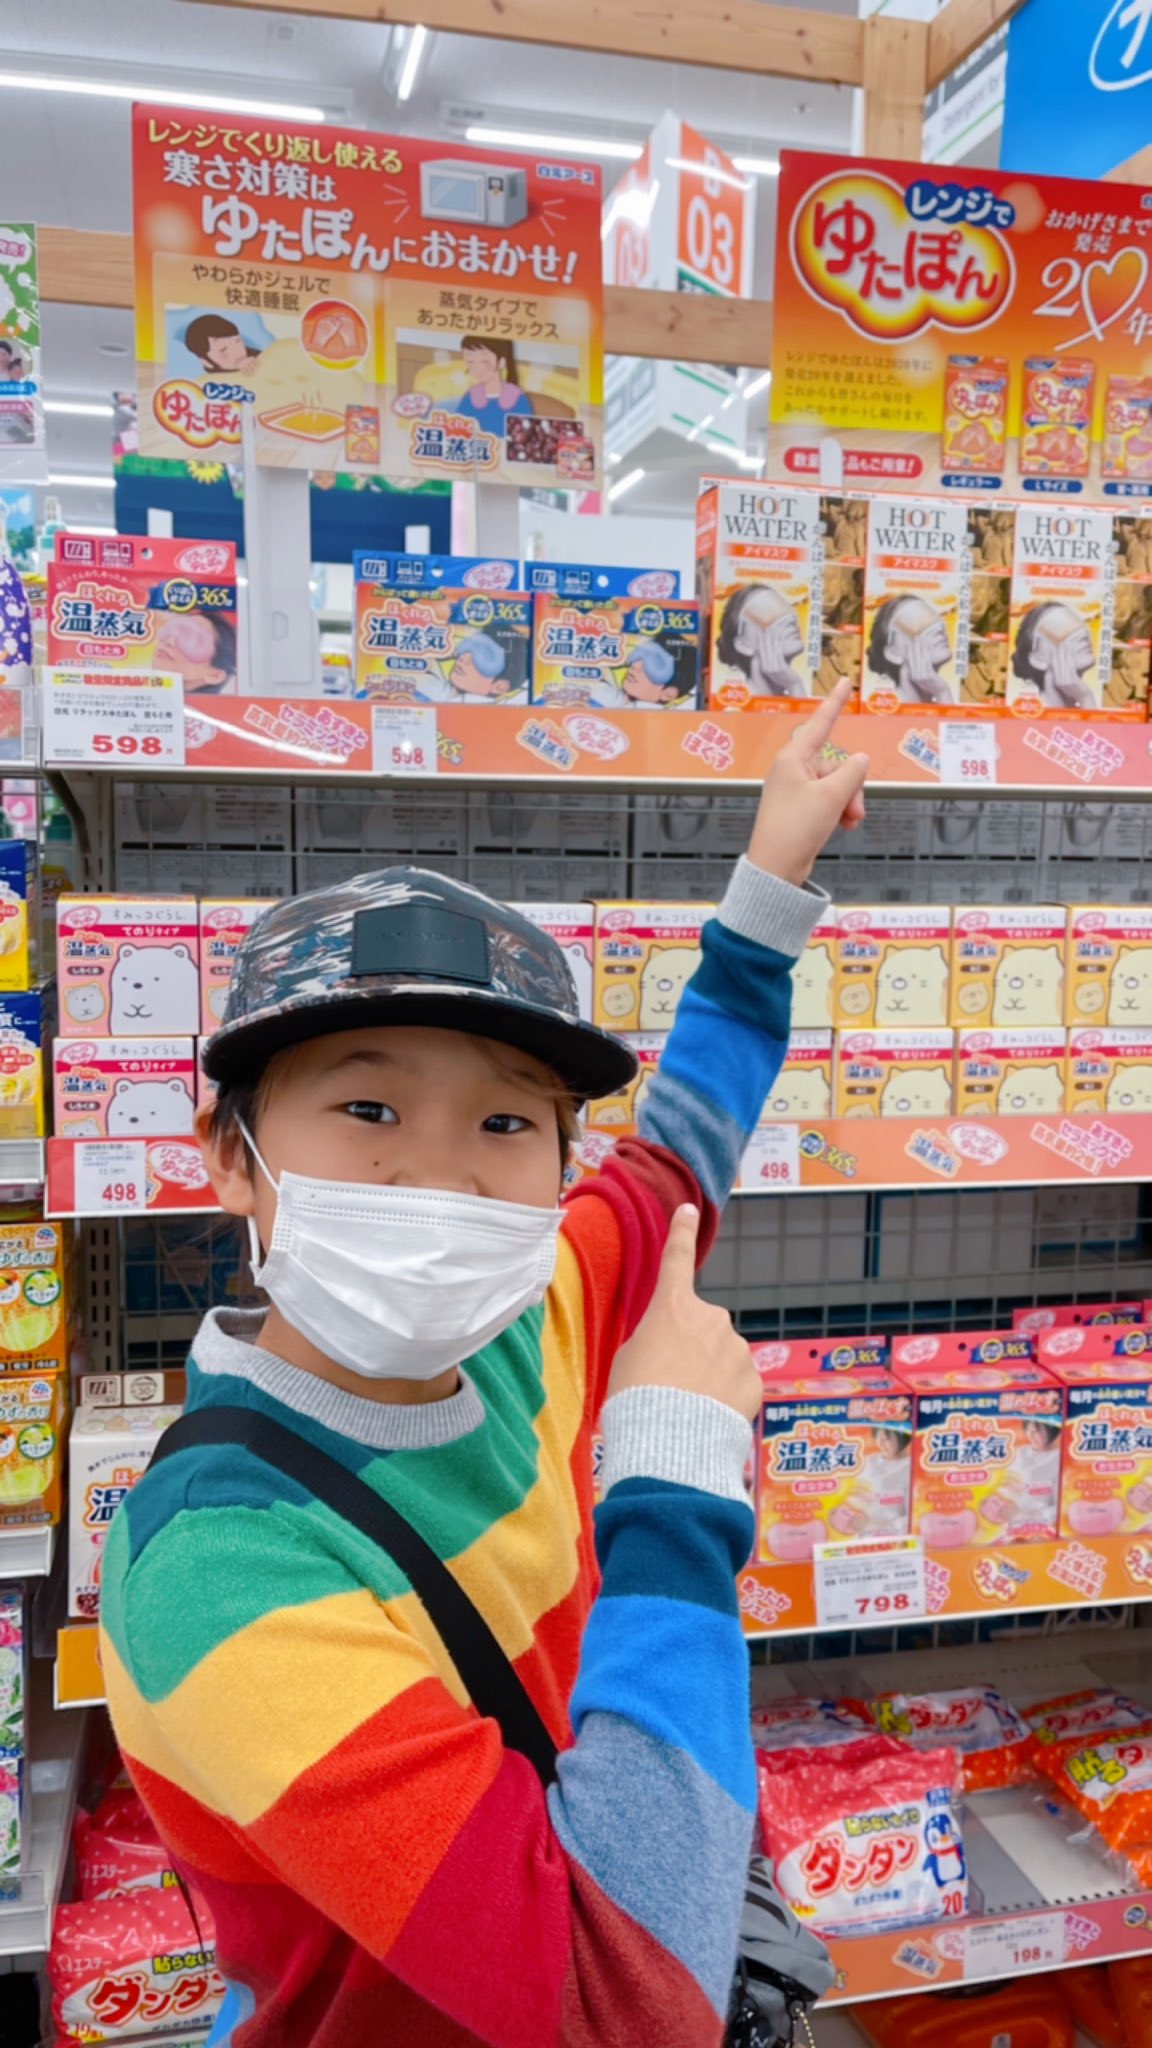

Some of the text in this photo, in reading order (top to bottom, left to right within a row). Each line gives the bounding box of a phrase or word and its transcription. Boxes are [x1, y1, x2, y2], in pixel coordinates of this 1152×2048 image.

[148, 118, 403, 174] レンジでくり返し使える
[163, 149, 337, 201] 寒さ対策は
[911, 186, 1011, 226] レンジで
[1044, 208, 1152, 237] おかげさまで
[687, 195, 735, 286] 03
[813, 200, 1000, 300] ゆたぽん
[1071, 235, 1113, 254] 発売
[192, 263, 331, 295] やわらかジェルで
[225, 286, 300, 311] 快適睡眠
[439, 290, 537, 317] 蒸気タイプで
[416, 307, 560, 339] あったかリラックス
[415, 427, 491, 462] 温蒸気
[739, 494, 797, 517] HOT
[723, 515, 808, 541] WATER
[889, 508, 947, 529] HOT
[1035, 516, 1092, 538] HOT
[874, 528, 956, 551] WATER
[1021, 537, 1101, 559] WATER
[744, 546, 789, 559] アイマスク
[893, 558, 938, 569] アイマスク
[1038, 566, 1084, 578] アイマスク
[59, 601, 147, 637] 温蒸気
[368, 617, 447, 650] 温蒸気
[546, 628, 619, 659] 温蒸気
[92, 734, 162, 756] 598
[392, 747, 424, 764] 598
[961, 760, 989, 775] 598
[122, 926, 181, 937] てのりタイプ
[119, 1061, 176, 1073] てのりタイプ
[761, 1163, 789, 1179] 498
[102, 1182, 137, 1201] 498
[777, 1441, 856, 1473] 温蒸気
[930, 1433, 1008, 1464] 温蒸気
[742, 1577, 790, 1611] あったか
[855, 1593, 909, 1615] 798
[90, 1864, 127, 1879] エステー
[806, 1838, 915, 1893] ダンダン
[943, 1891, 963, 1917] 20
[74, 1959, 112, 1972] エステー
[1014, 1947, 1041, 1964] 198
